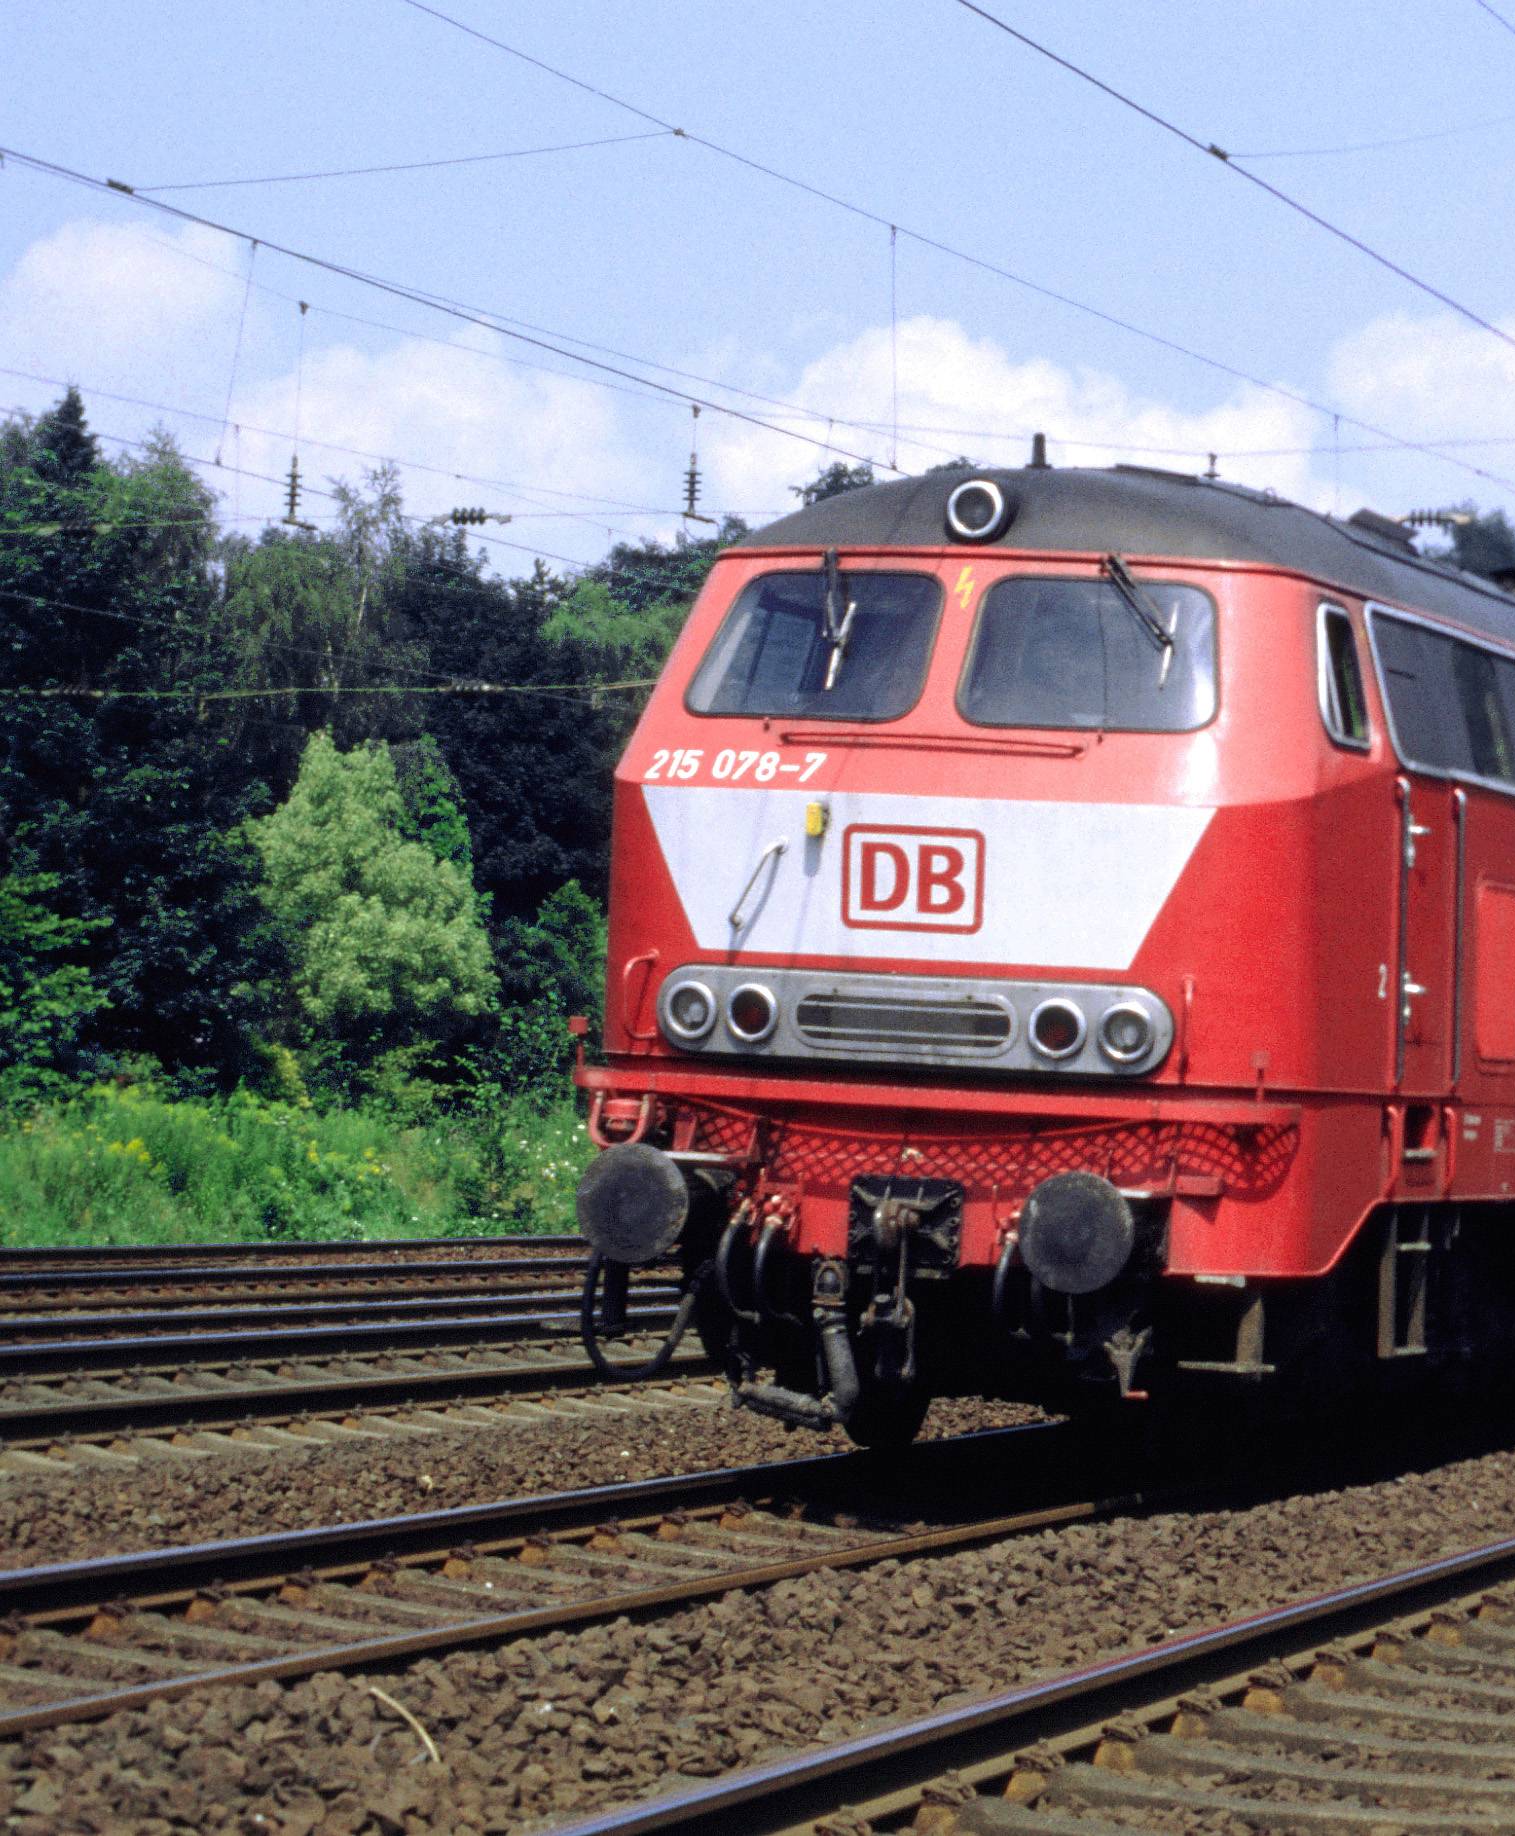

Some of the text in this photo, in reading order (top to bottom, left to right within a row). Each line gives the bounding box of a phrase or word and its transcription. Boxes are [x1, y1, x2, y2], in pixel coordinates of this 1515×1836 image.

[644, 749, 827, 782] 215 078-7
[859, 841, 966, 914] DB
